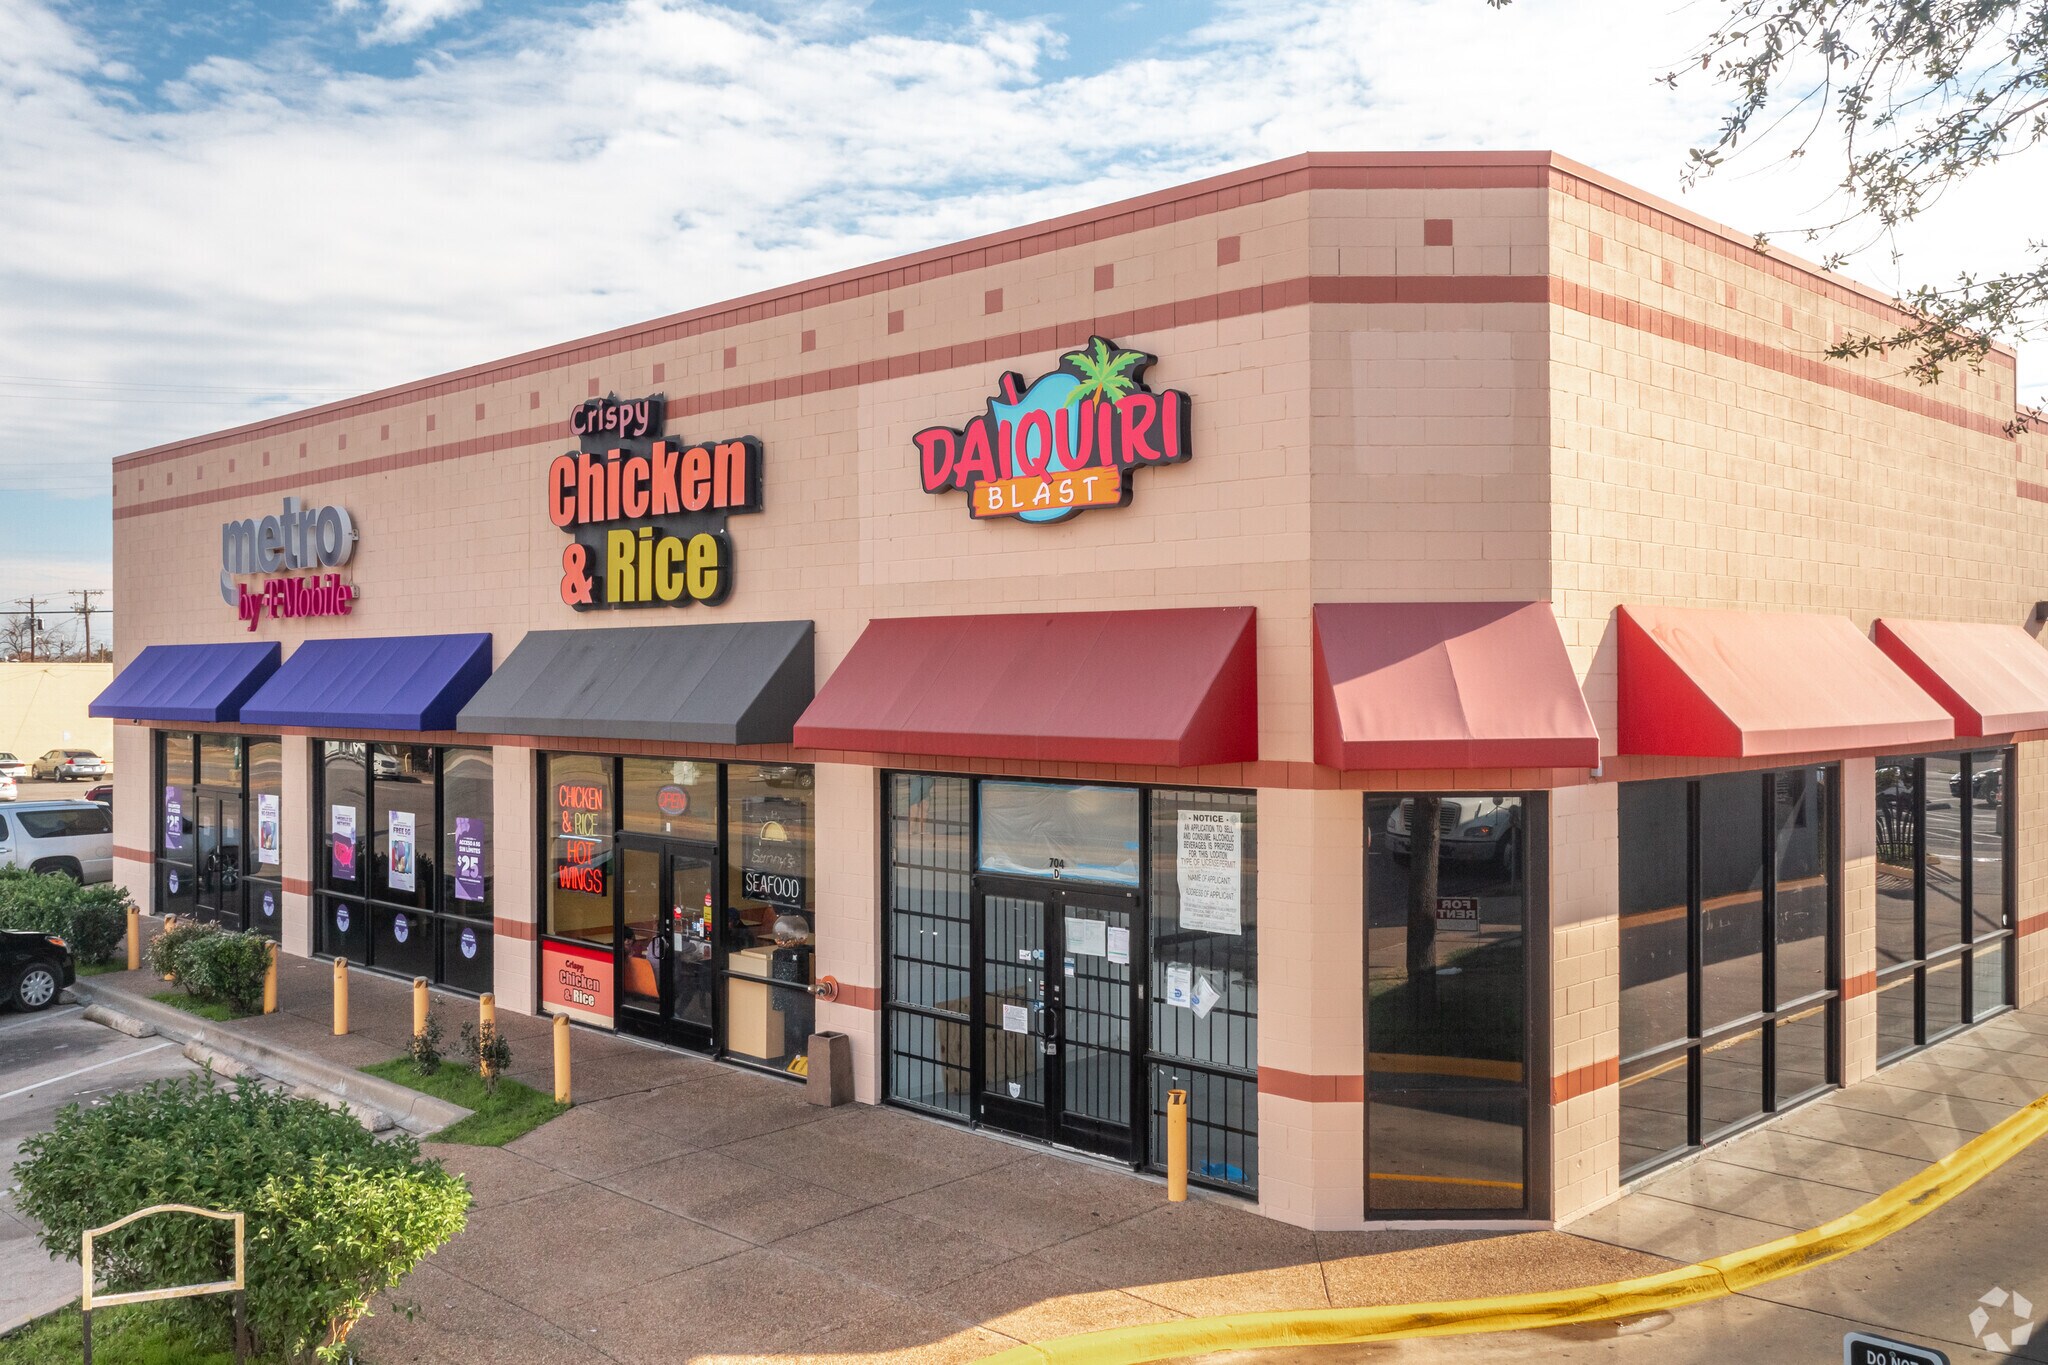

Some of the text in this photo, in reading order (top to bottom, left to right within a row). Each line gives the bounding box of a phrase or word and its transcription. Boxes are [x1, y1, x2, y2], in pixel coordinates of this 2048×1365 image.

[570, 399, 649, 438] Crispy
[915, 391, 1179, 491] DAIQUIRI
[548, 440, 747, 527] Chicken
[988, 475, 1099, 510] BLAST
[221, 496, 352, 606] metro
[560, 526, 719, 605] & Rice
[238, 574, 353, 632] by T-Mobile
[559, 785, 603, 810] CHICKEN
[658, 792, 687, 809] OPEN
[562, 811, 599, 836] & RICE
[1190, 824, 1215, 832] APPLICATION
[1193, 814, 1224, 823] NOTICE
[567, 840, 596, 865] HOT
[1183, 841, 1207, 850] BEVERAGES
[1214, 842, 1234, 852] PROPOSED
[1188, 850, 1198, 858] FOR
[1198, 850, 1209, 859] THIS
[457, 855, 479, 878] $25
[1049, 857, 1065, 869] 704
[1054, 868, 1060, 879] D
[559, 865, 603, 894] WINGS
[746, 872, 799, 898] SEAFOOD
[565, 960, 584, 973] Crispy
[559, 969, 600, 992] Chicken
[564, 988, 595, 1007] & Rice
[1866, 1350, 1887, 1365] DO
